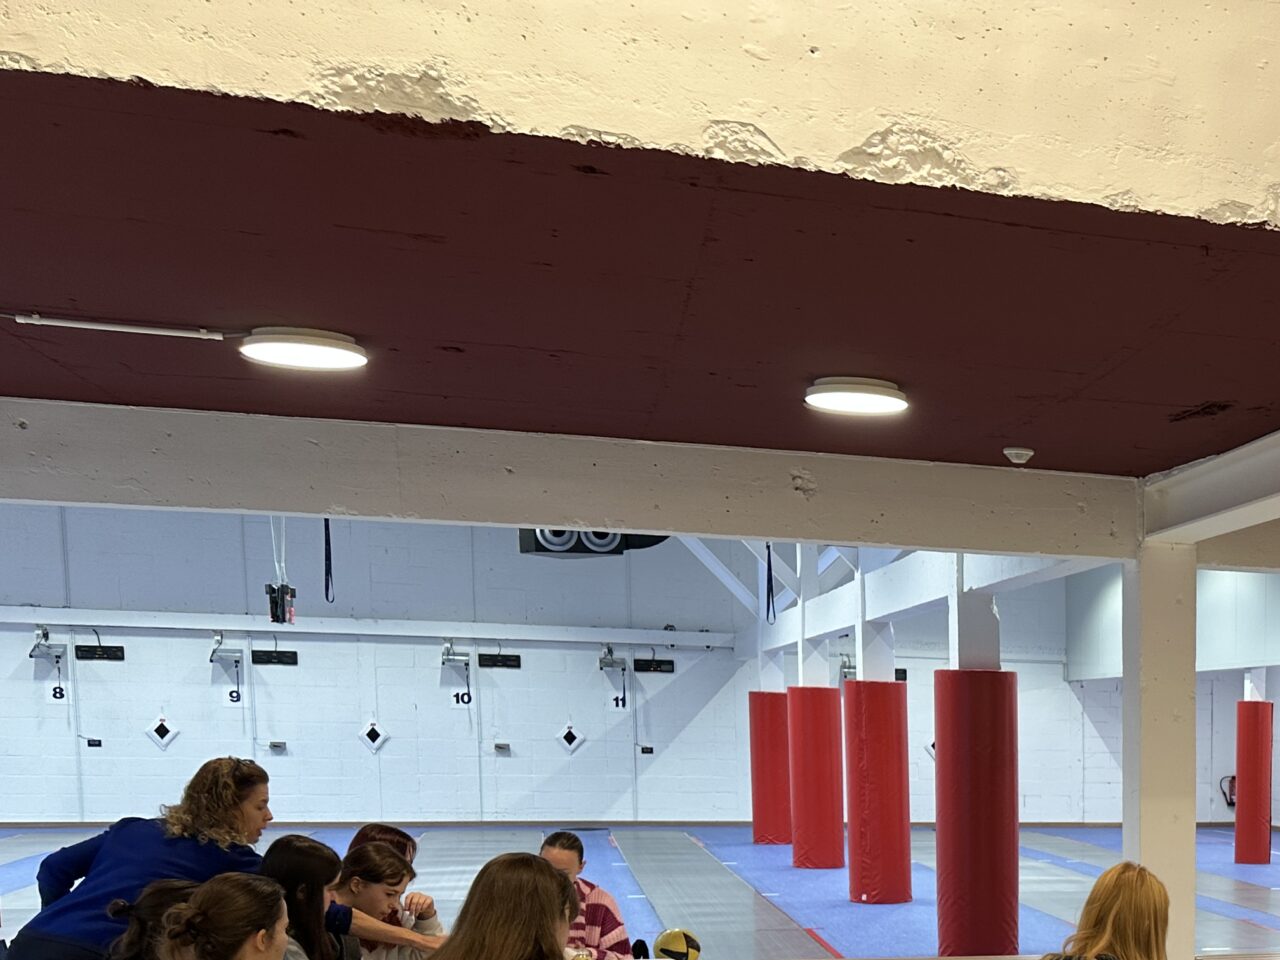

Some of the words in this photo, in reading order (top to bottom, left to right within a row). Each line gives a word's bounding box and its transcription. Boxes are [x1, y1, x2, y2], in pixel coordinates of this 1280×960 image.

[52, 686, 65, 699] 8
[228, 690, 241, 702] 9
[453, 692, 472, 704] 10
[613, 696, 627, 708] 11
